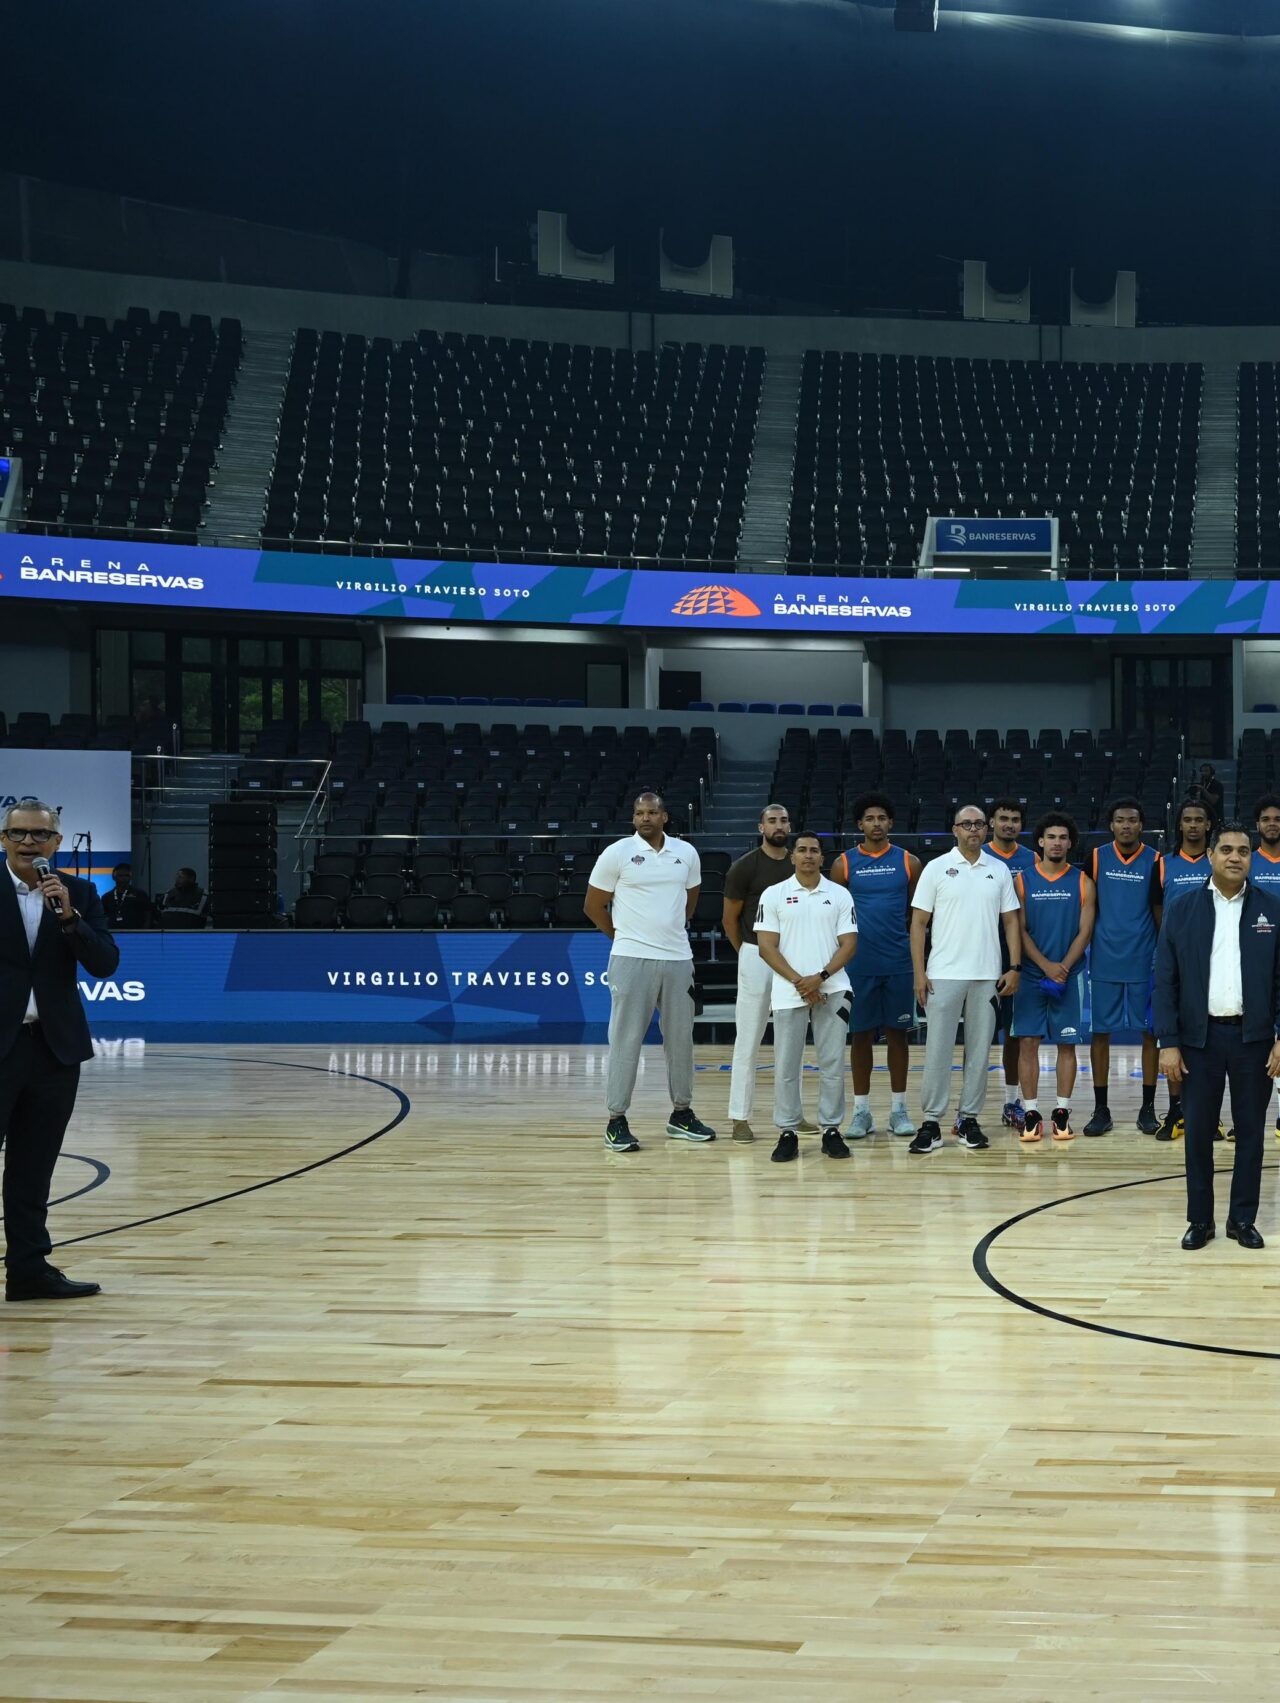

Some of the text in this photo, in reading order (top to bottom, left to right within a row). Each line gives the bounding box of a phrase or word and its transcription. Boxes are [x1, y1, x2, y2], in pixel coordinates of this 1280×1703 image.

[968, 532, 1037, 541] BANRESERVAS
[20, 555, 150, 572] ARENA
[20, 566, 204, 590] BANRESERVAS
[336, 581, 530, 598] VIRGILIO TRAVIESO SOTO
[774, 593, 870, 604] ARENA
[774, 603, 912, 618] BANRESERVAS
[1014, 603, 1176, 612] VIRGILIO TRAVIESO SOTO
[327, 971, 438, 986] VIRGILIO
[451, 971, 570, 986] TRAVIESO
[77, 980, 146, 1002] VAS
